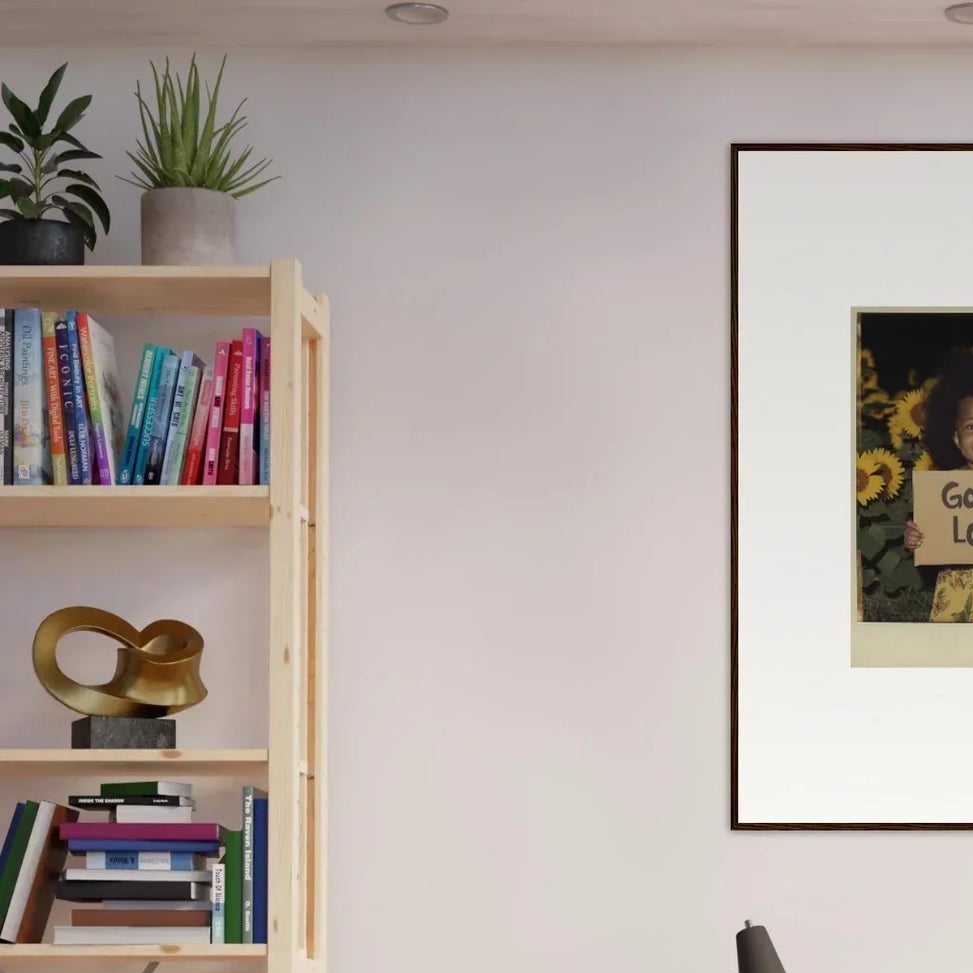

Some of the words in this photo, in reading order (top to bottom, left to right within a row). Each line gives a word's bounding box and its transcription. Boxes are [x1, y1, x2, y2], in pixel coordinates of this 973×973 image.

[22, 325, 32, 340] Oil
[80, 327, 94, 374] Watercolor
[18, 342, 32, 386] Paintings
[48, 363, 56, 379] ART
[59, 344, 73, 408] ICONIC
[73, 360, 82, 385] Beauty
[230, 363, 241, 396] Parenting
[50, 385, 58, 402] With
[75, 394, 83, 408] ART
[86, 375, 98, 411] Portraits
[50, 402, 60, 425] Digital
[229, 397, 238, 416] Skills
[53, 425, 62, 442] Tools
[244, 850, 252, 880] Island
